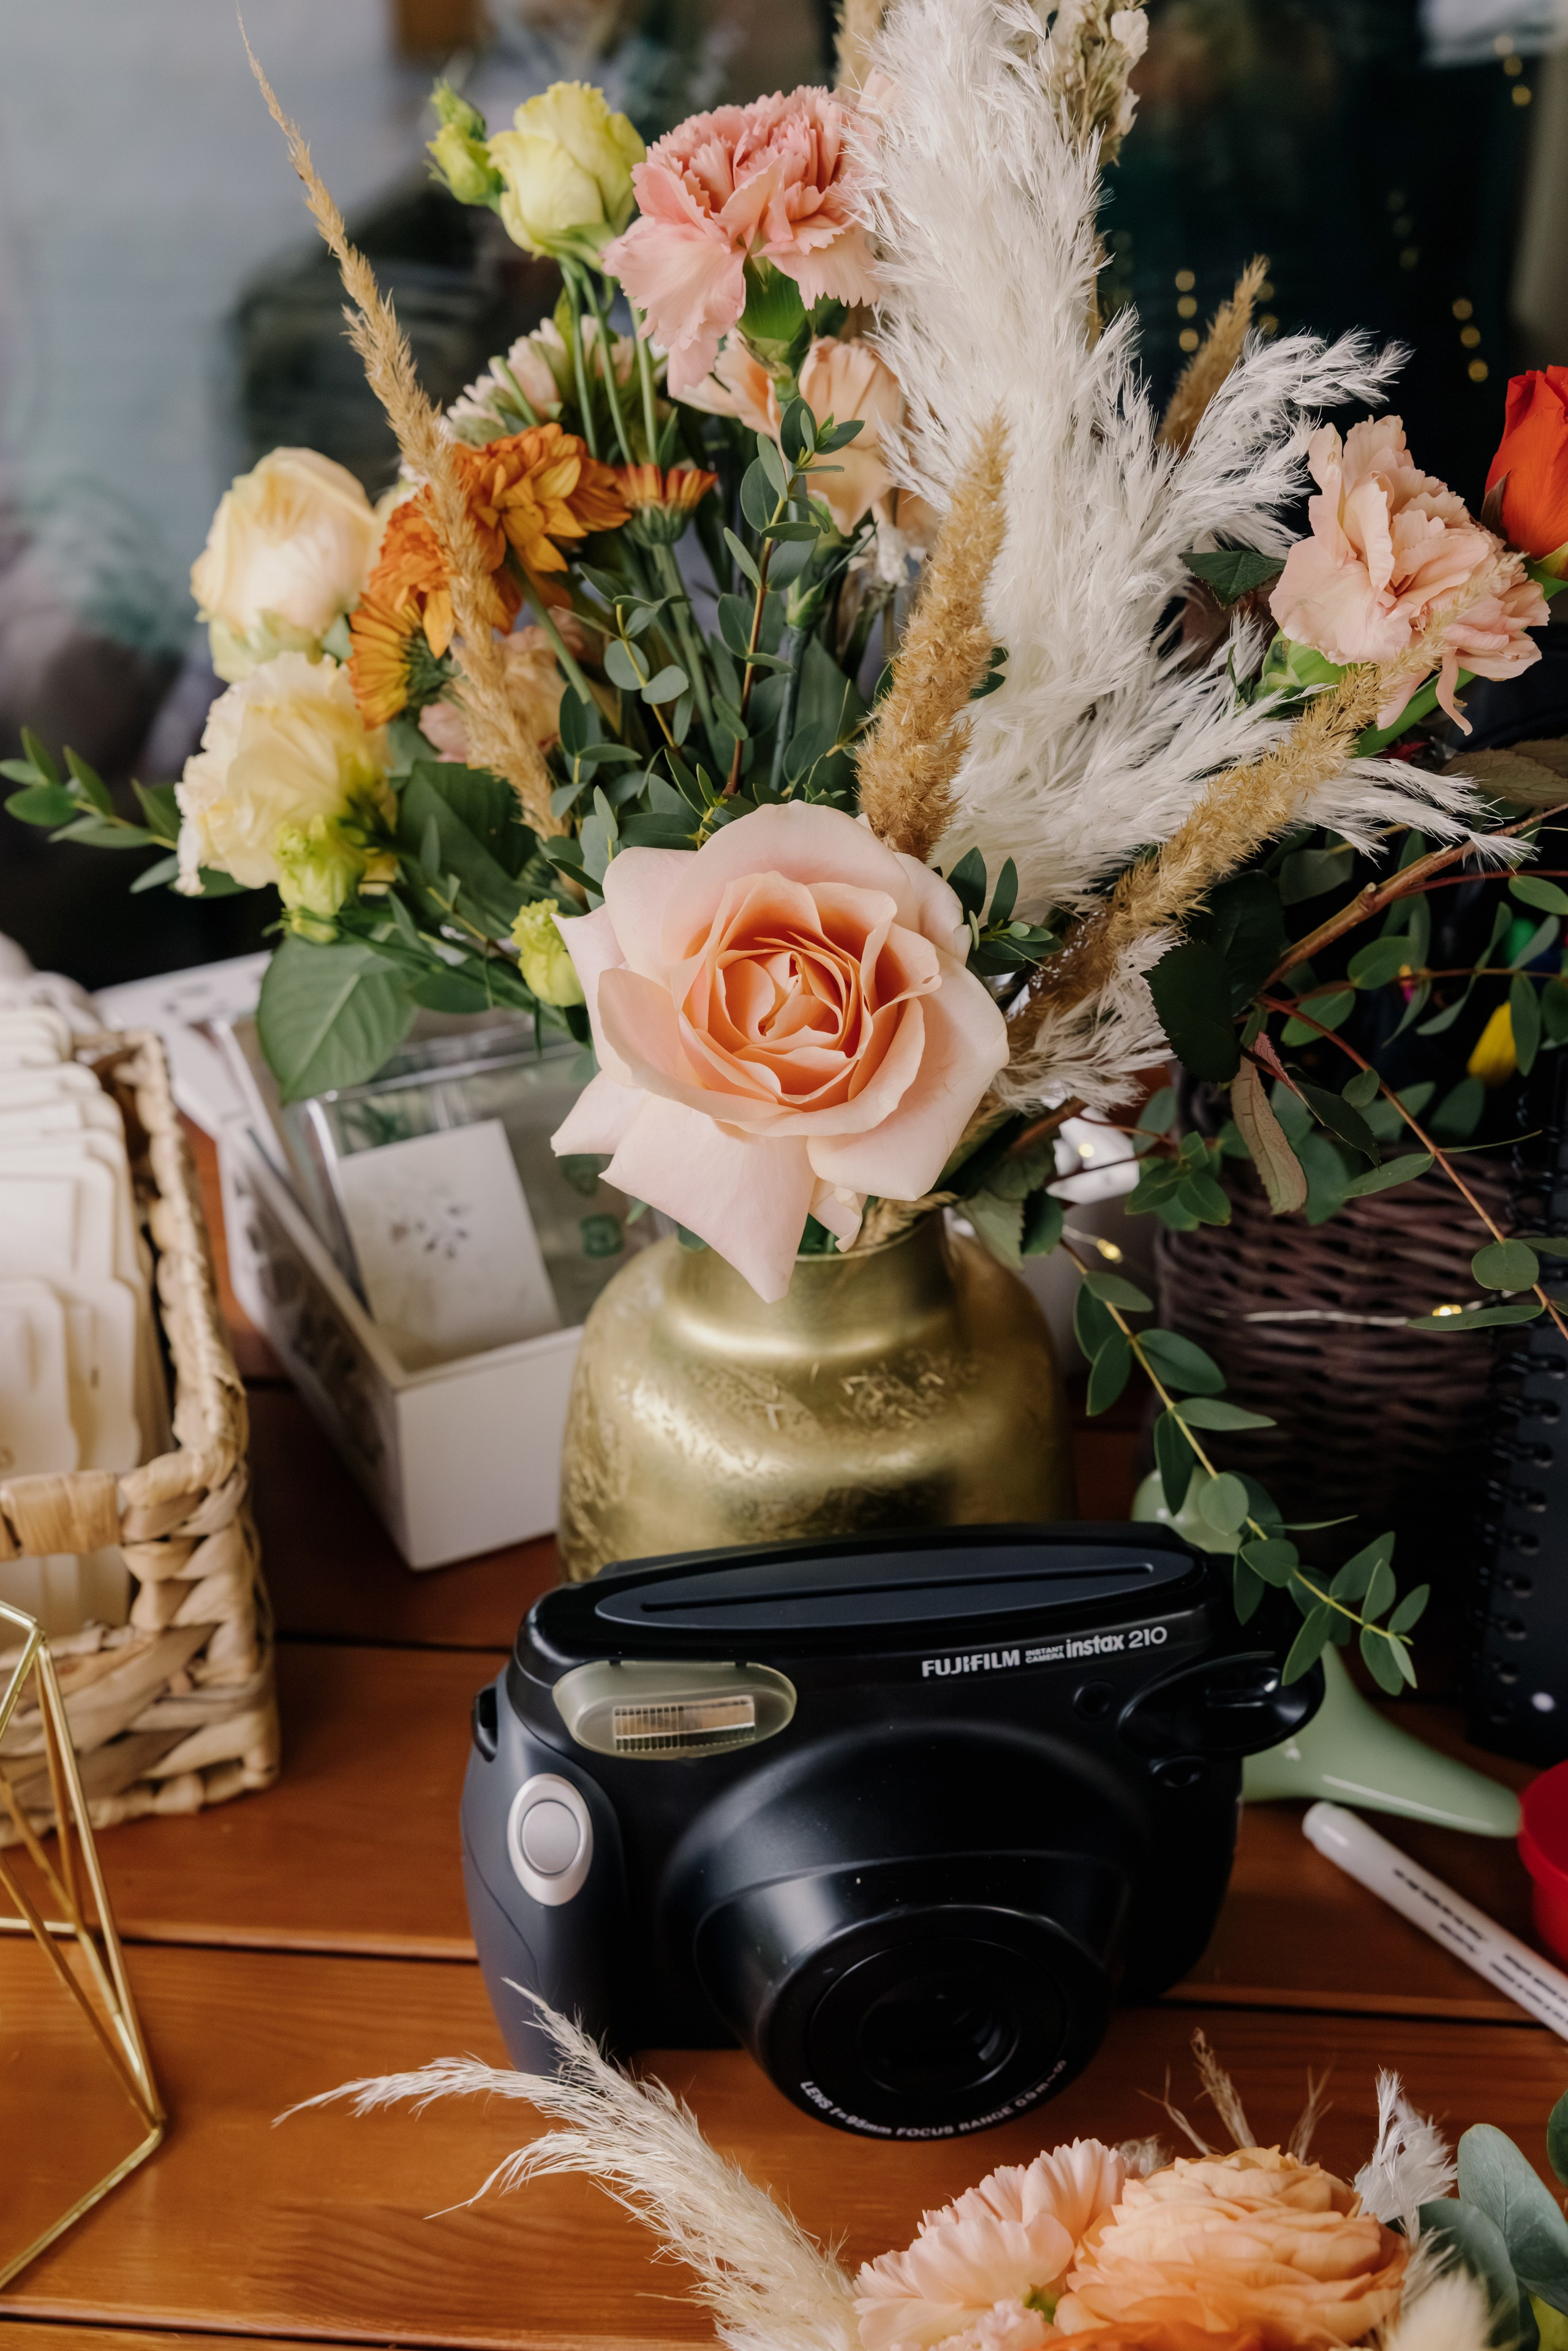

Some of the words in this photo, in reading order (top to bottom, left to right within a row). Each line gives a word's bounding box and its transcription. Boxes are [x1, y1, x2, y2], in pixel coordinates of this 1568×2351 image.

[1025, 1645, 1065, 1656] INSTANT
[1066, 1634, 1125, 1659] instax
[1128, 1626, 1167, 1649] 210
[922, 1649, 1020, 1677] FUJIFILM
[1025, 1651, 1065, 1664] CAMERA
[799, 2081, 834, 2110] LENS
[895, 2125, 955, 2138] FOCUS
[958, 2106, 1014, 2132] RANGE
